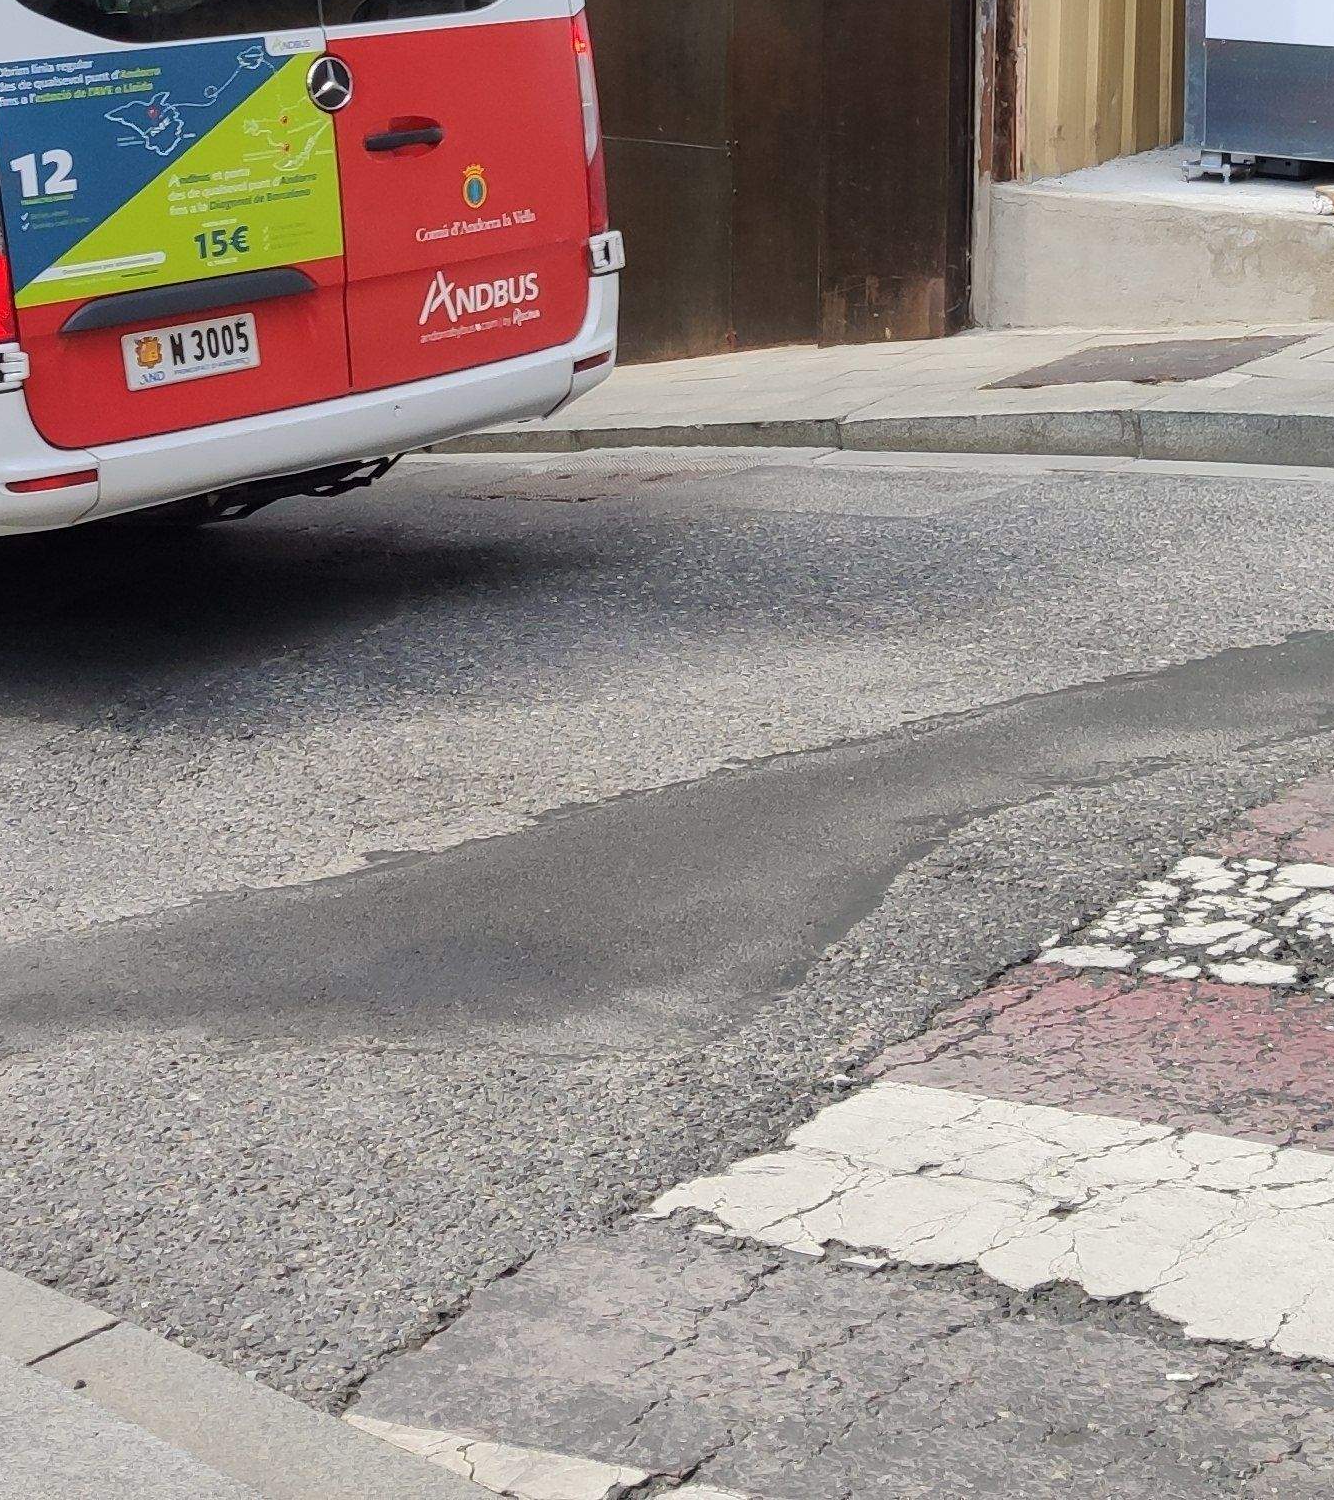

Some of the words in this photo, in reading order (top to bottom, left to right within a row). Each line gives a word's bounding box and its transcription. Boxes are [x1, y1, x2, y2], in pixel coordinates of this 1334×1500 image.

[9, 148, 78, 197] 12
[194, 225, 250, 260] 15€
[419, 270, 540, 326] ANDBUS
[190, 321, 249, 361] 3005
